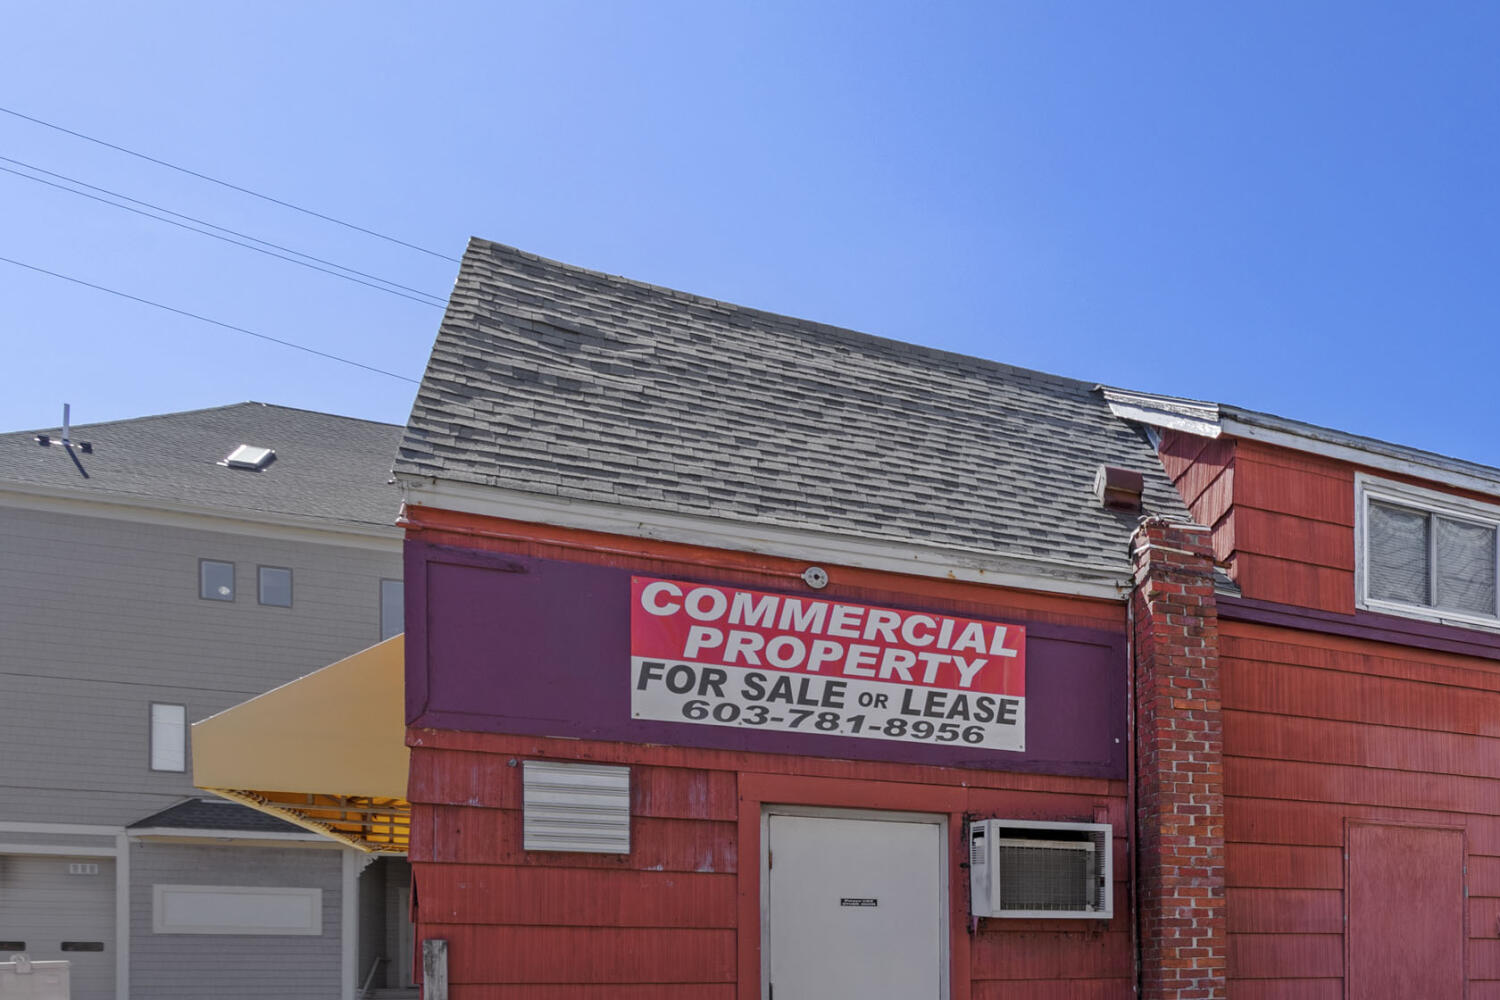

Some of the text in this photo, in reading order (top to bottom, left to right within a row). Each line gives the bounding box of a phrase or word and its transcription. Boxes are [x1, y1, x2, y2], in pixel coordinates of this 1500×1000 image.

[641, 582, 1018, 657] COMMERCIAL
[683, 626, 987, 688] PROPERTY
[637, 662, 1019, 725] FOR SALE OR LEASE
[682, 700, 985, 744] 603-781-8956
